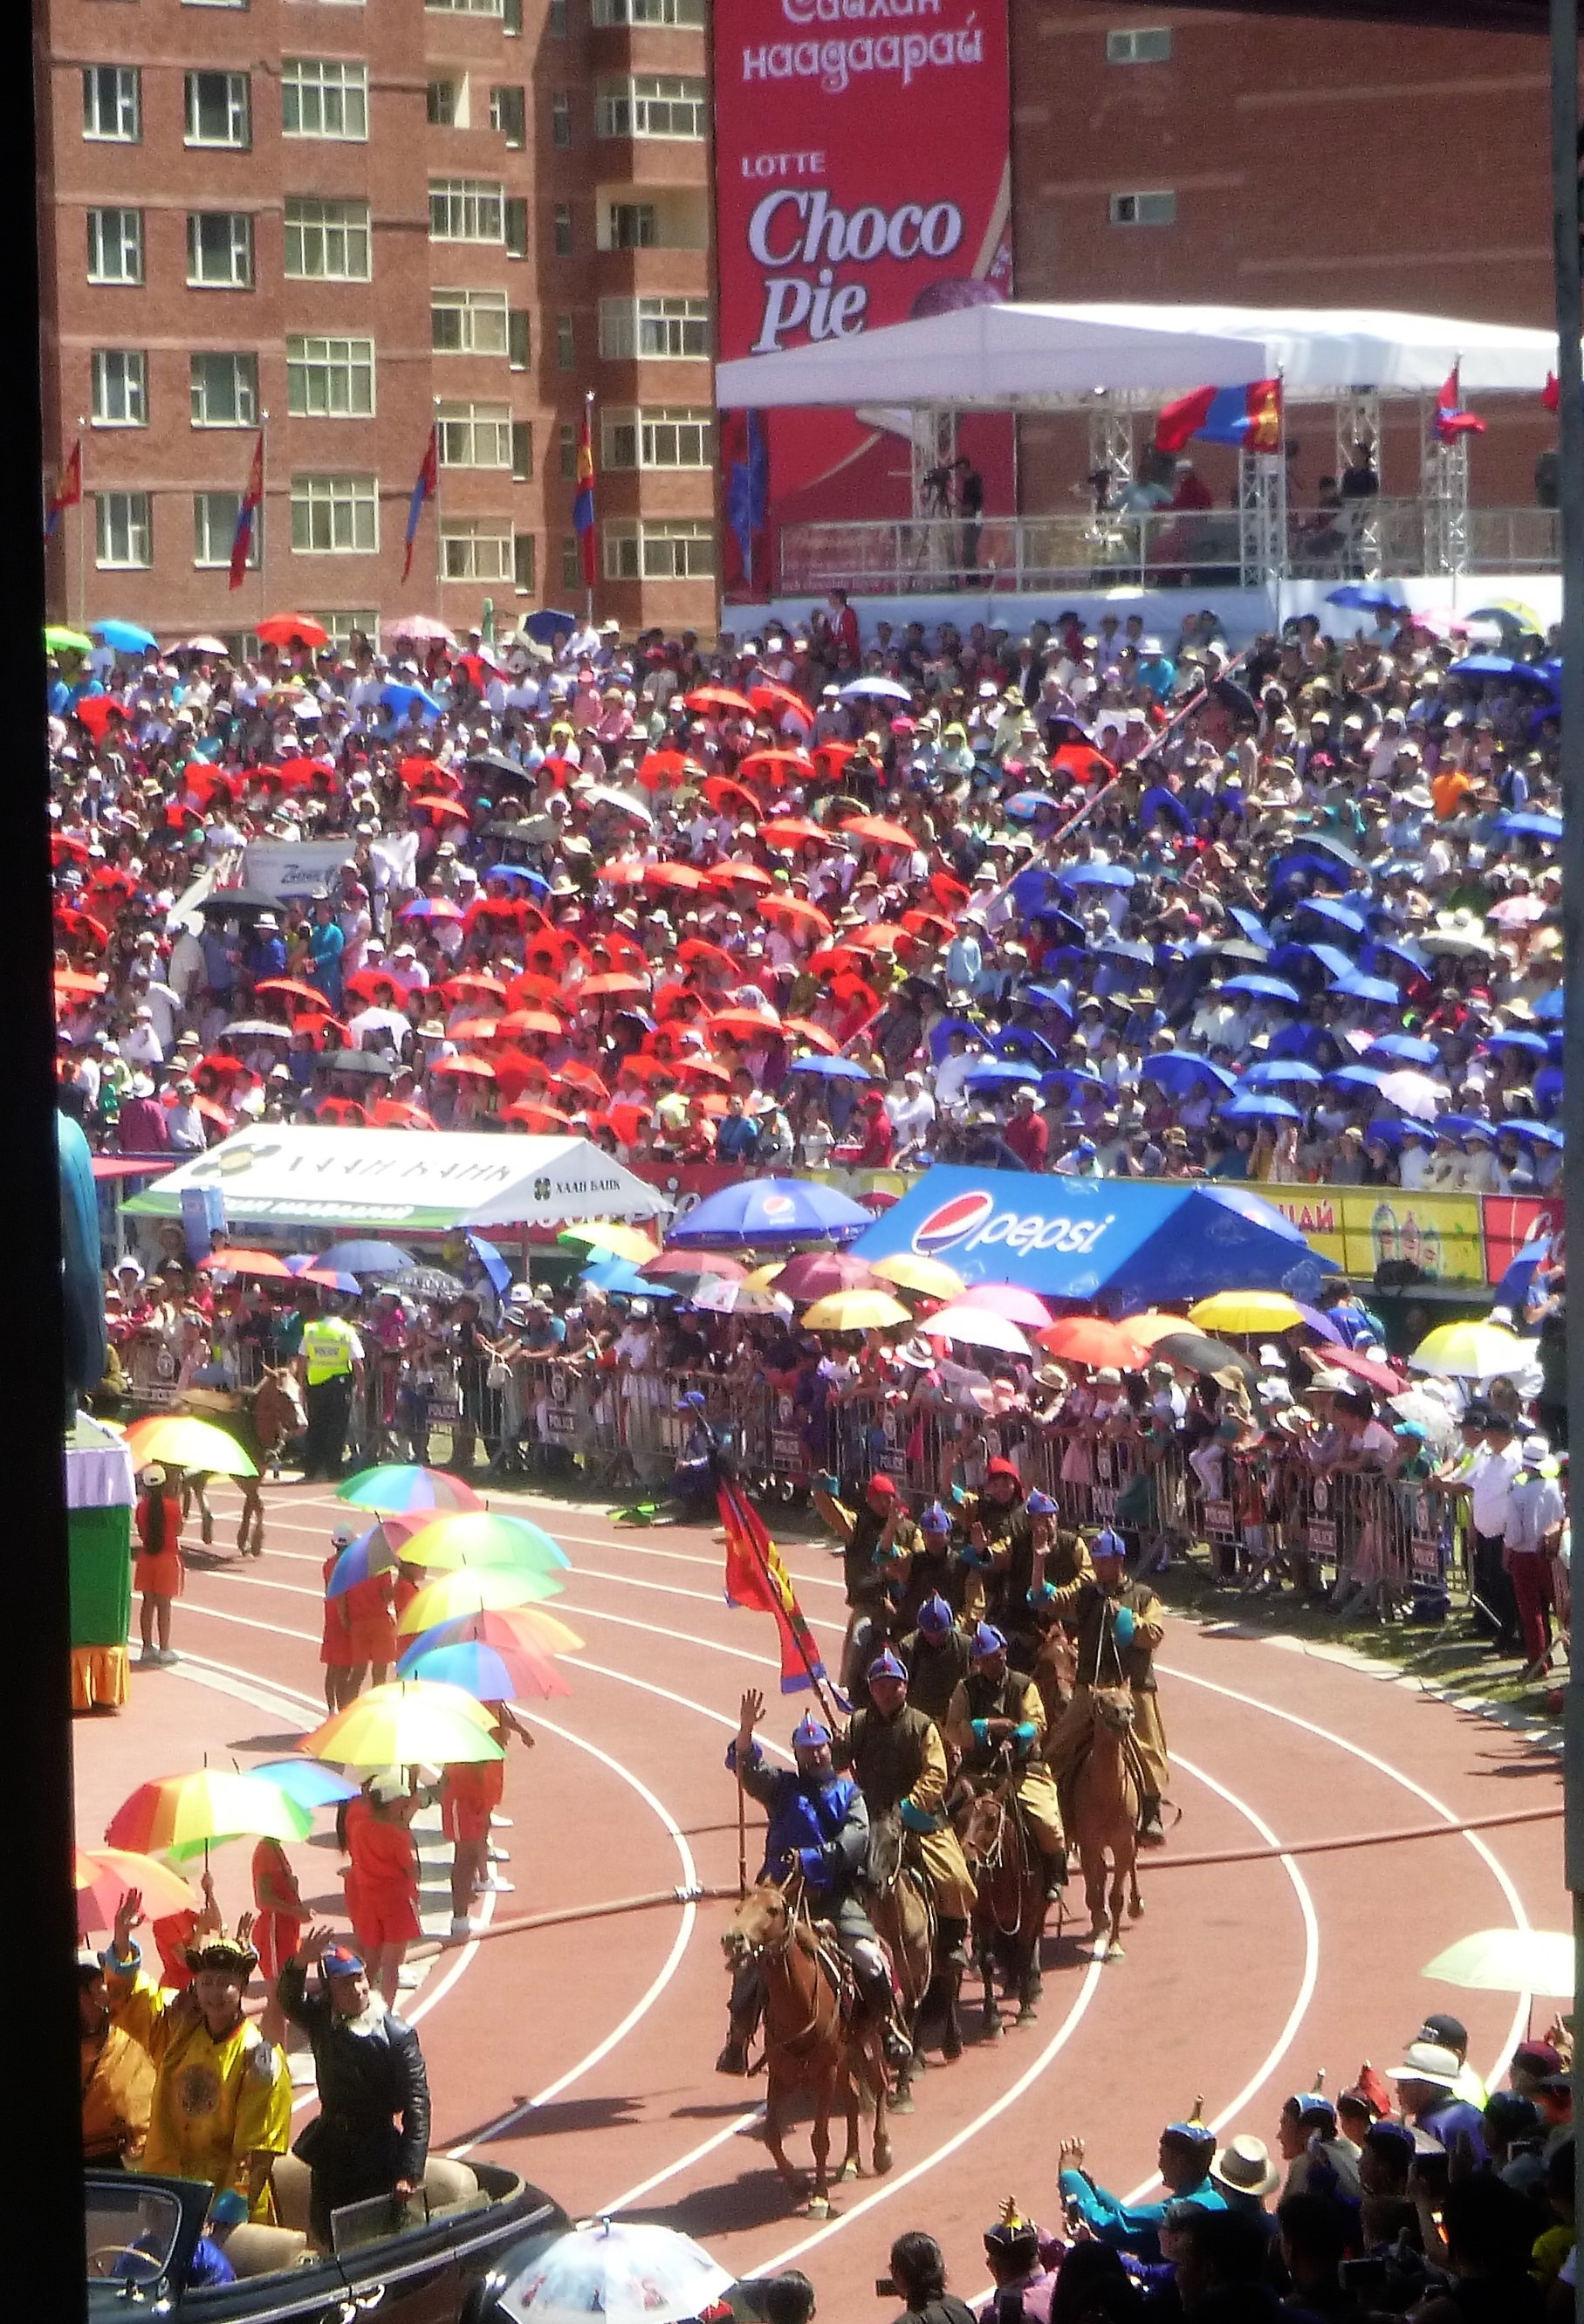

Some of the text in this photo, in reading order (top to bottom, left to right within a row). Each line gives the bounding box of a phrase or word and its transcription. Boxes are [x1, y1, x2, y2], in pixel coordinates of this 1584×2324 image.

[742, 152, 826, 178] LOTTE
[748, 188, 963, 268] Choco
[750, 268, 869, 354] Pie
[964, 1213, 1116, 1258] pepsi
